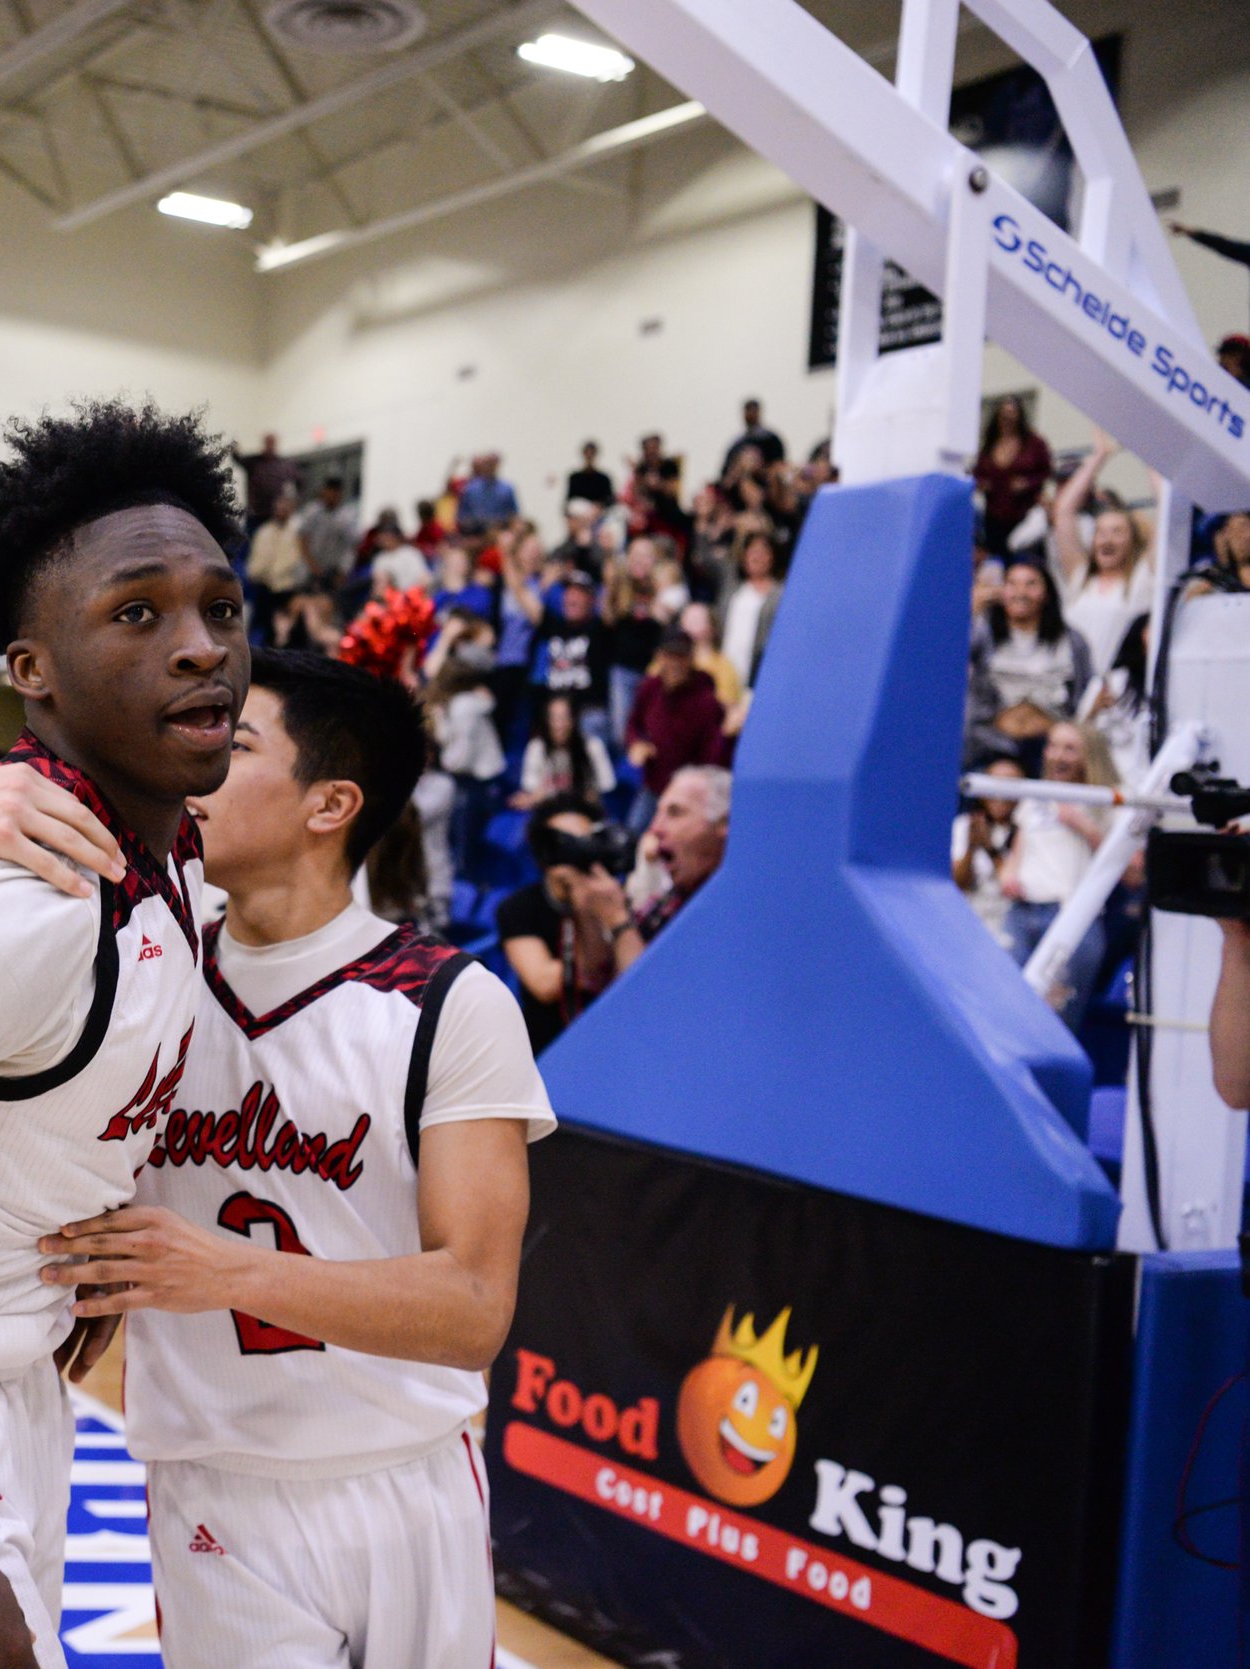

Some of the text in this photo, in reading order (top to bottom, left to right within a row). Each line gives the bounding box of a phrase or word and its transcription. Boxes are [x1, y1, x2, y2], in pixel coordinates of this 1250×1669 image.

[1151, 345, 1246, 439] Sports
[511, 1347, 1022, 1620] Food King
[594, 1466, 871, 1610] Cost Plus Food
